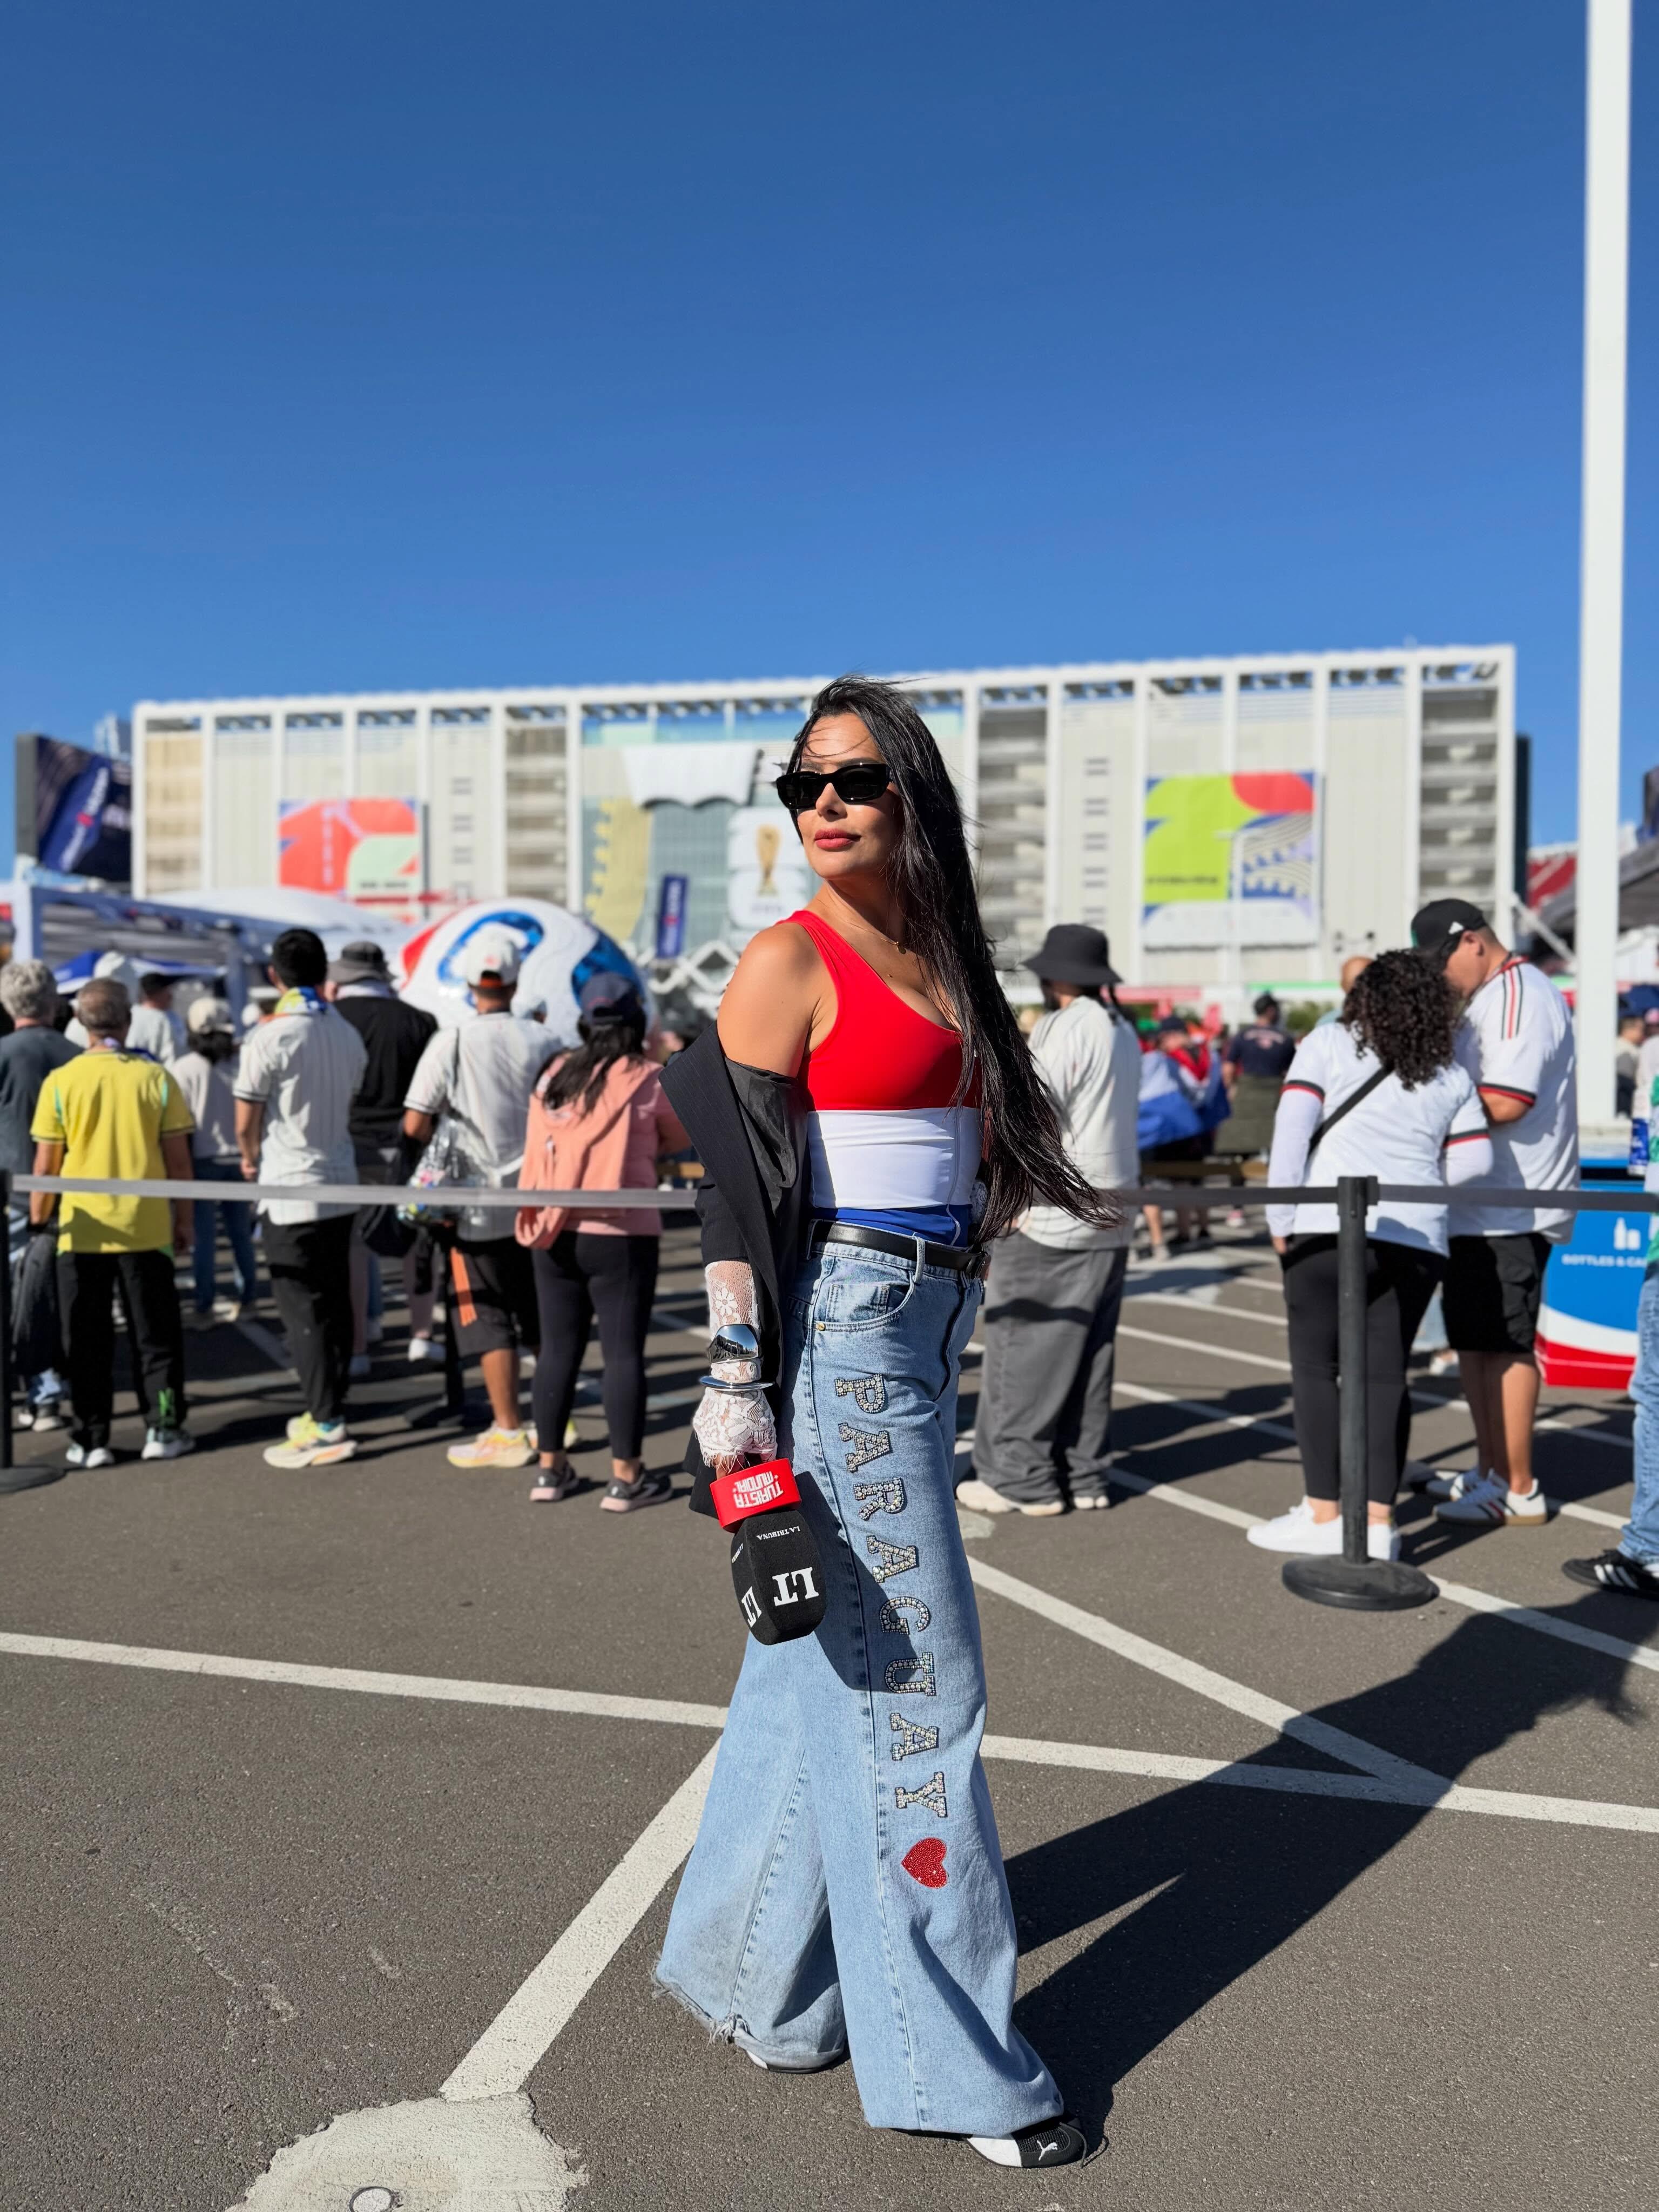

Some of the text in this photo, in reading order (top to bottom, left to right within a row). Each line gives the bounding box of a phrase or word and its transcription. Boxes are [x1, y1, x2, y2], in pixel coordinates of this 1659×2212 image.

[733, 1481, 784, 1508] TURISTA
[734, 1471, 774, 1493] MUNDIAL
[756, 1528, 790, 1540] TRIBUNA
[772, 1567, 819, 1607] LT
[834, 1373, 948, 1818] PARAGUAY
[741, 1586, 762, 1628] LT
